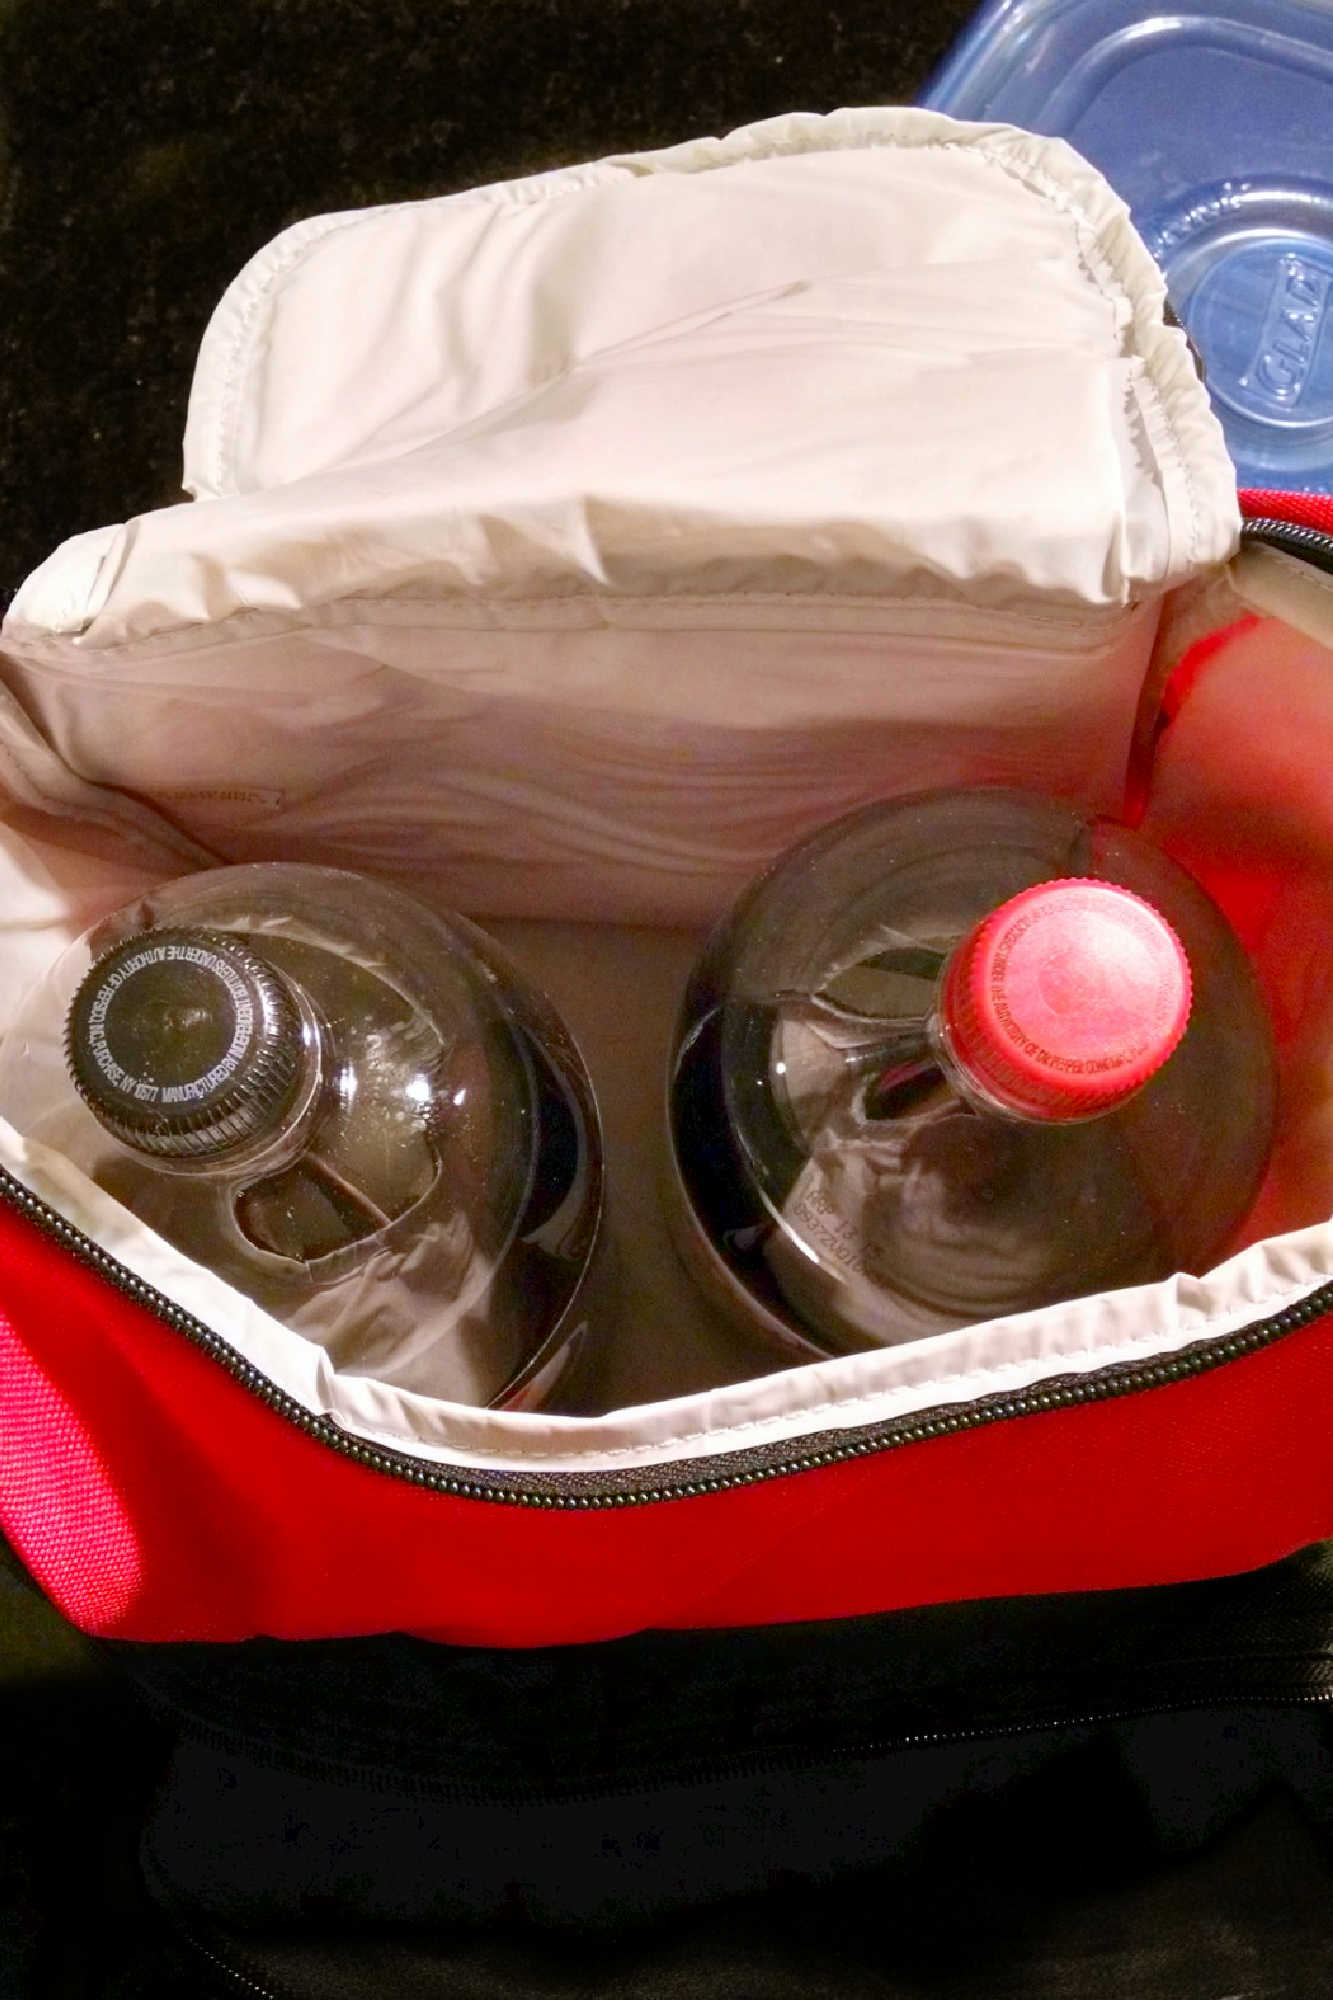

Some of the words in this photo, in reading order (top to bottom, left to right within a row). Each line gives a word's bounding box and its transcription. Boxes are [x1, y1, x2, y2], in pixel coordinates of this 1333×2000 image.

[1257, 262, 1320, 396] GLAD
[167, 944, 187, 960] THE
[121, 946, 167, 978] AUTHORITY
[103, 973, 123, 990] OF
[1023, 1041, 1038, 1056] OF
[120, 1074, 137, 1093] NY
